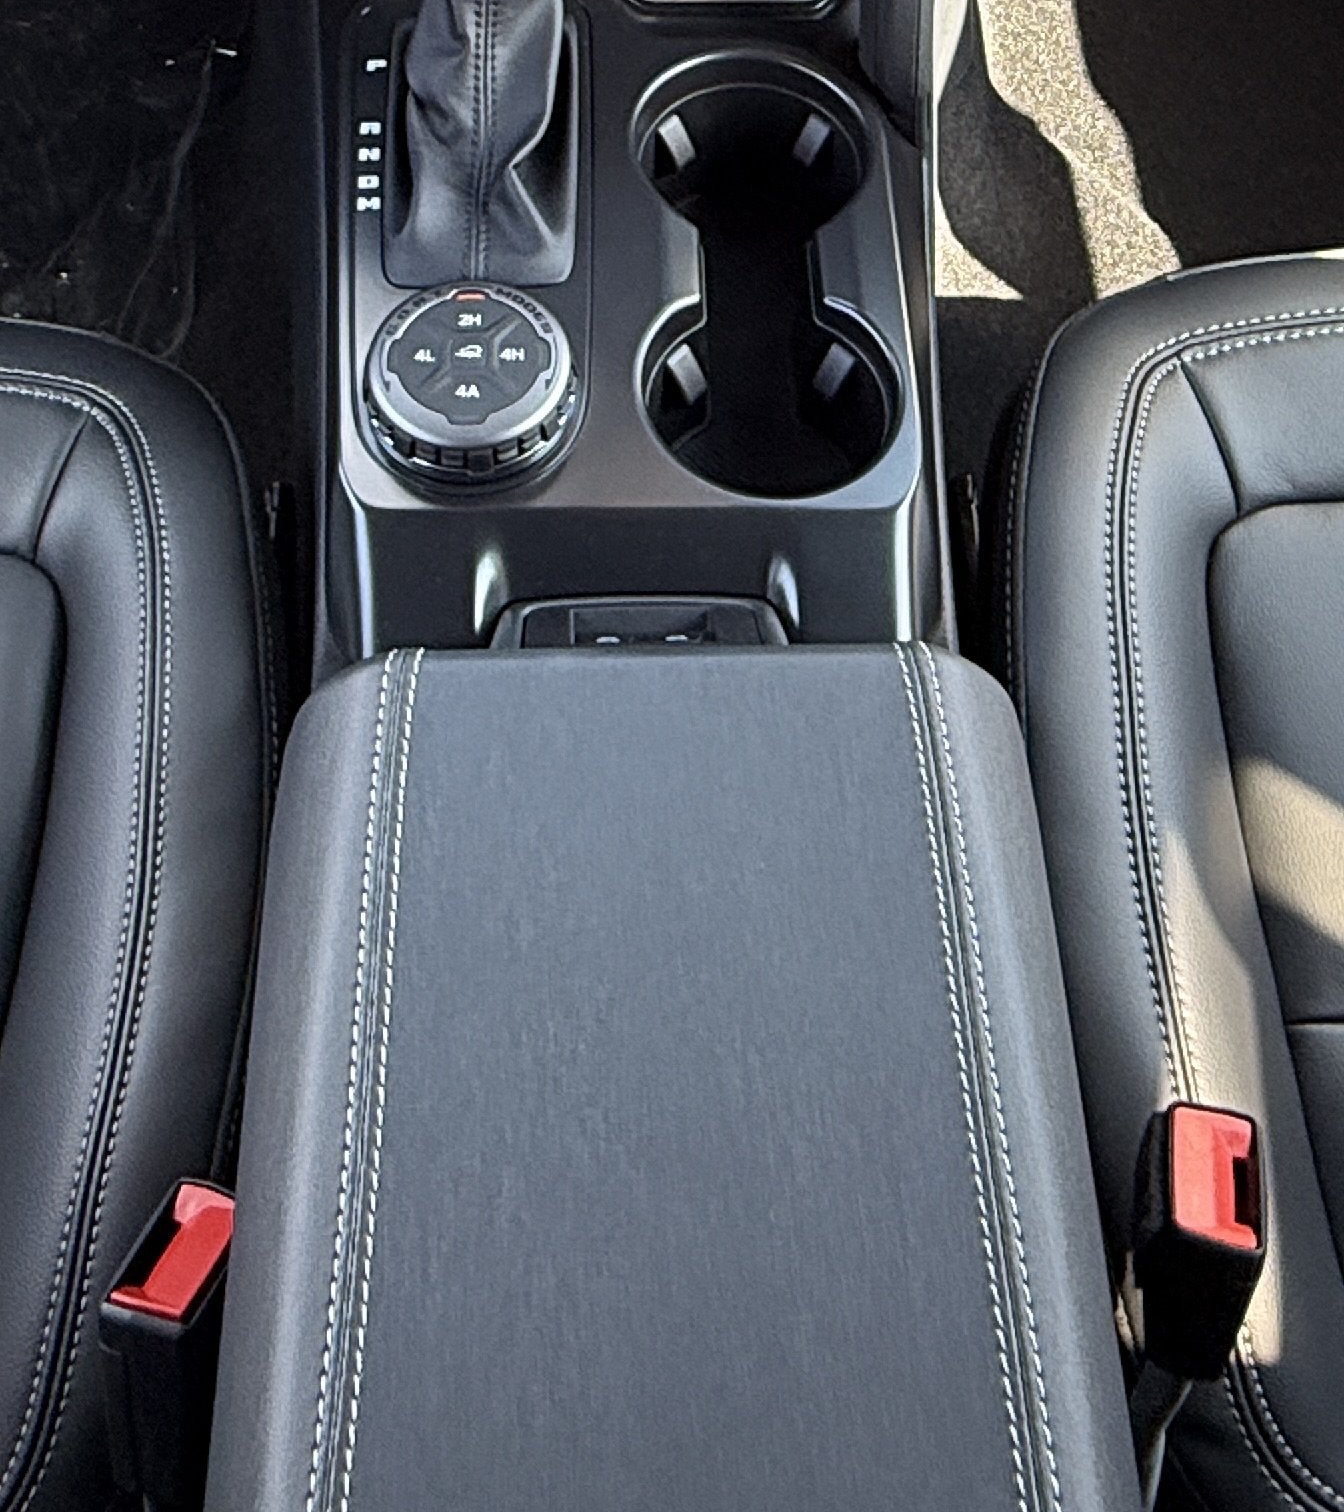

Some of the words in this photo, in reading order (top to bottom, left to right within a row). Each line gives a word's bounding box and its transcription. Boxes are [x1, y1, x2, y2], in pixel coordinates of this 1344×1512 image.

[358, 146, 381, 162] N
[358, 174, 380, 189] D
[356, 196, 381, 212] M
[457, 313, 482, 326] 2H
[413, 348, 436, 362] 4L
[499, 347, 525, 362] 4H
[455, 384, 480, 399] 4A
